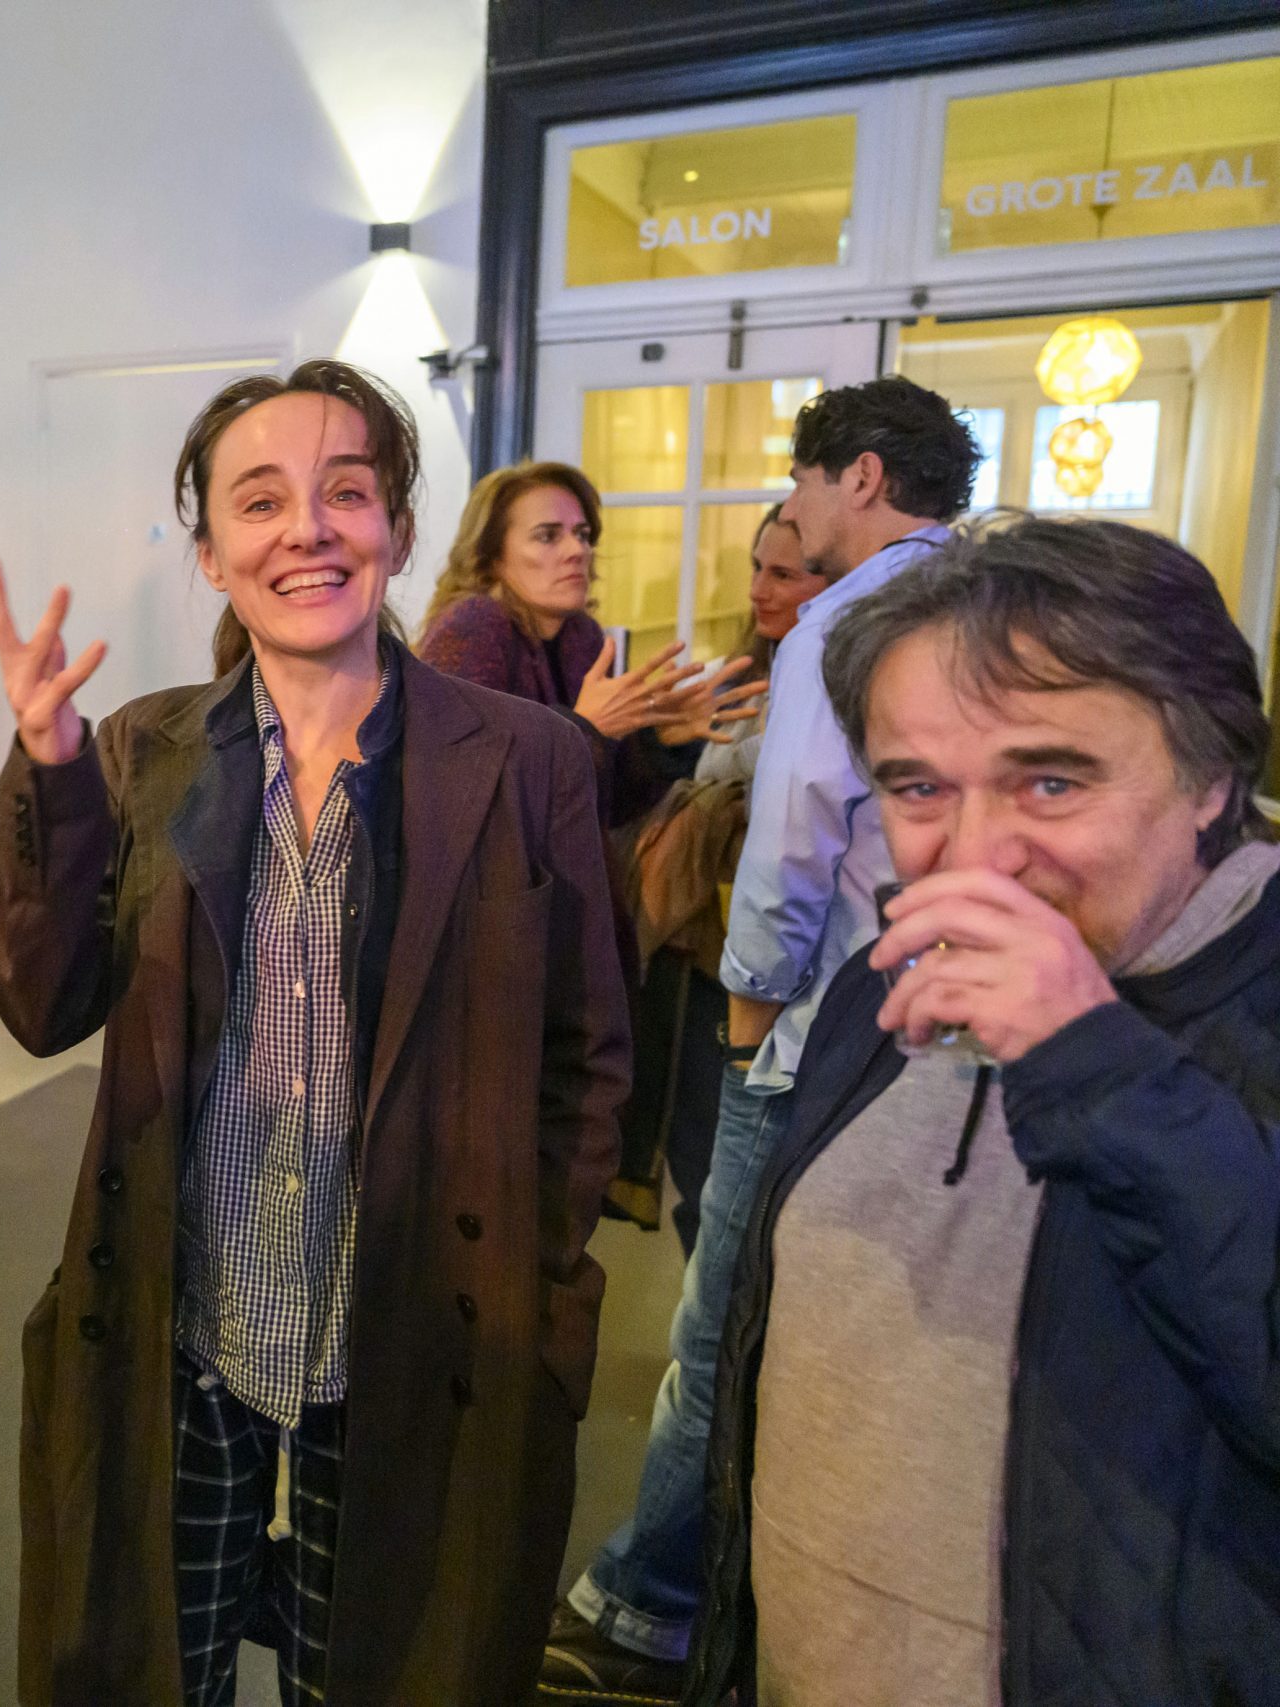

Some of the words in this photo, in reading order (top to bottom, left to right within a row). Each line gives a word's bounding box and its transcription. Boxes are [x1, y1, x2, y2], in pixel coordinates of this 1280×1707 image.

[966, 170, 1120, 217] GROTE
[1135, 156, 1266, 199] ZAAL
[639, 208, 772, 250] SALON
